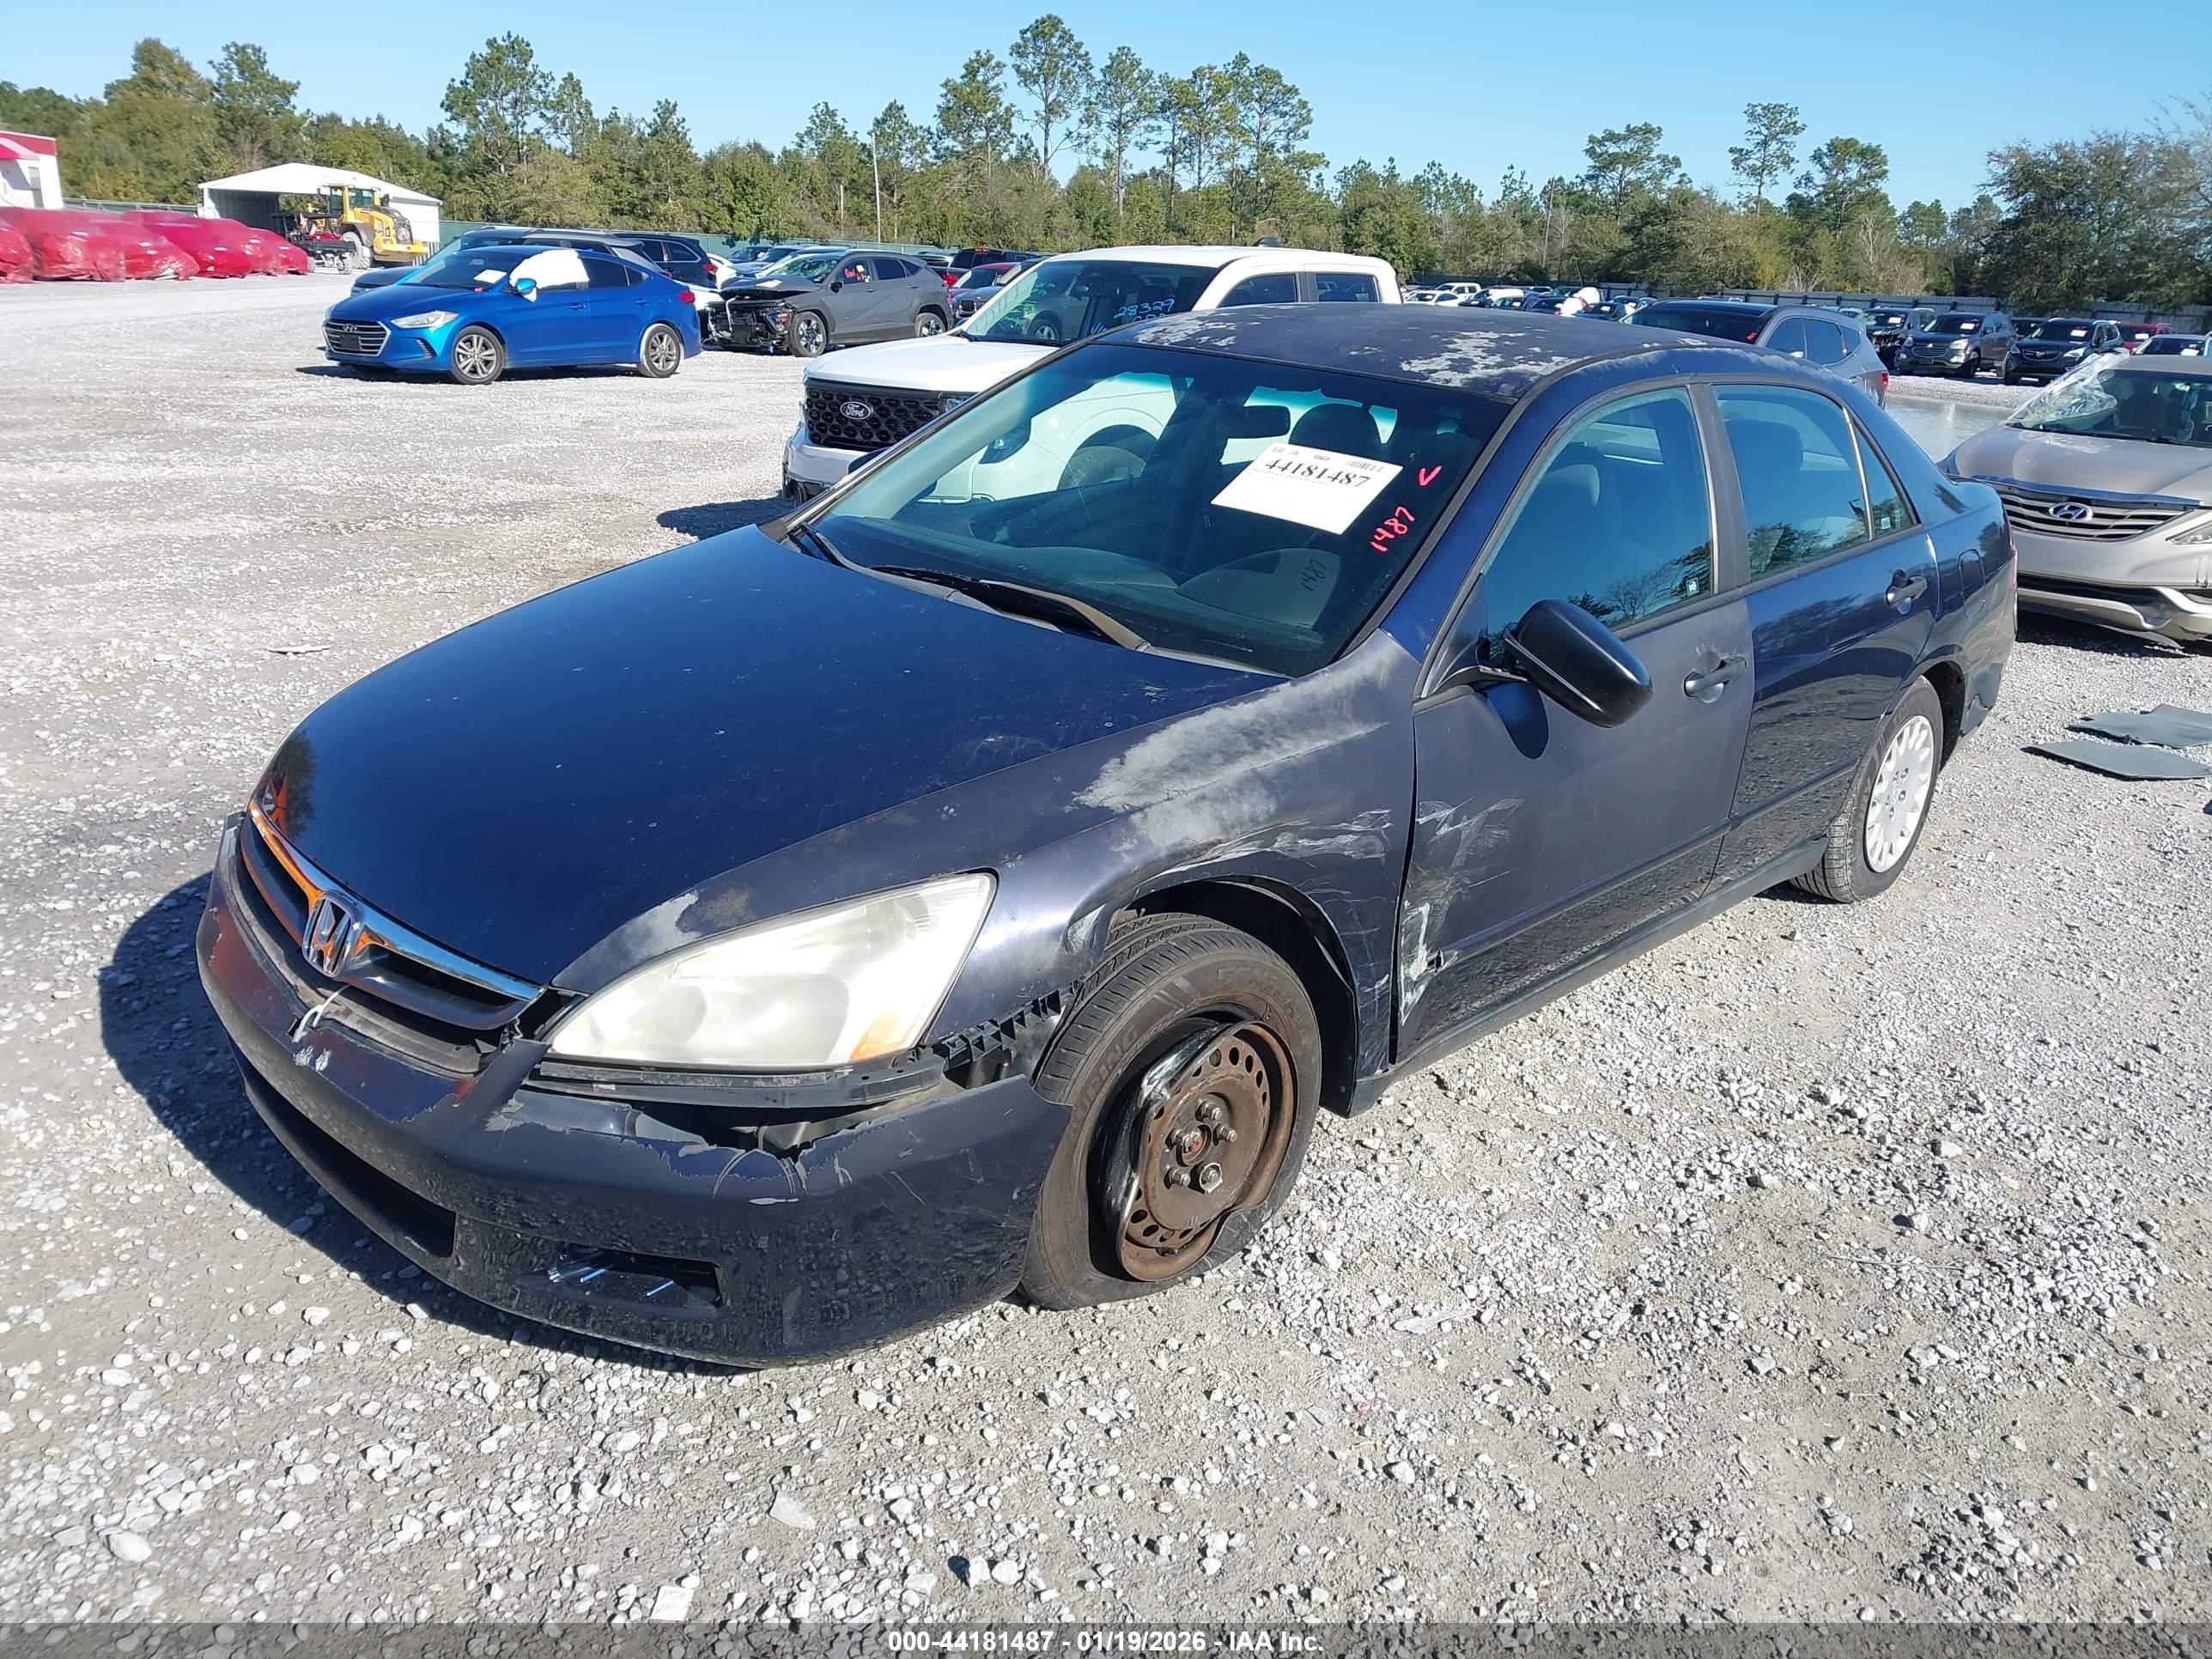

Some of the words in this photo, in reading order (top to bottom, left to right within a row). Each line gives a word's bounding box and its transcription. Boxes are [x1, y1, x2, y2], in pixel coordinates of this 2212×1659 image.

[1113, 298, 1176, 319] 28329
[845, 403, 865, 417] Ford
[1266, 458, 1371, 487] 44181487
[1369, 505, 1416, 553] 1487
